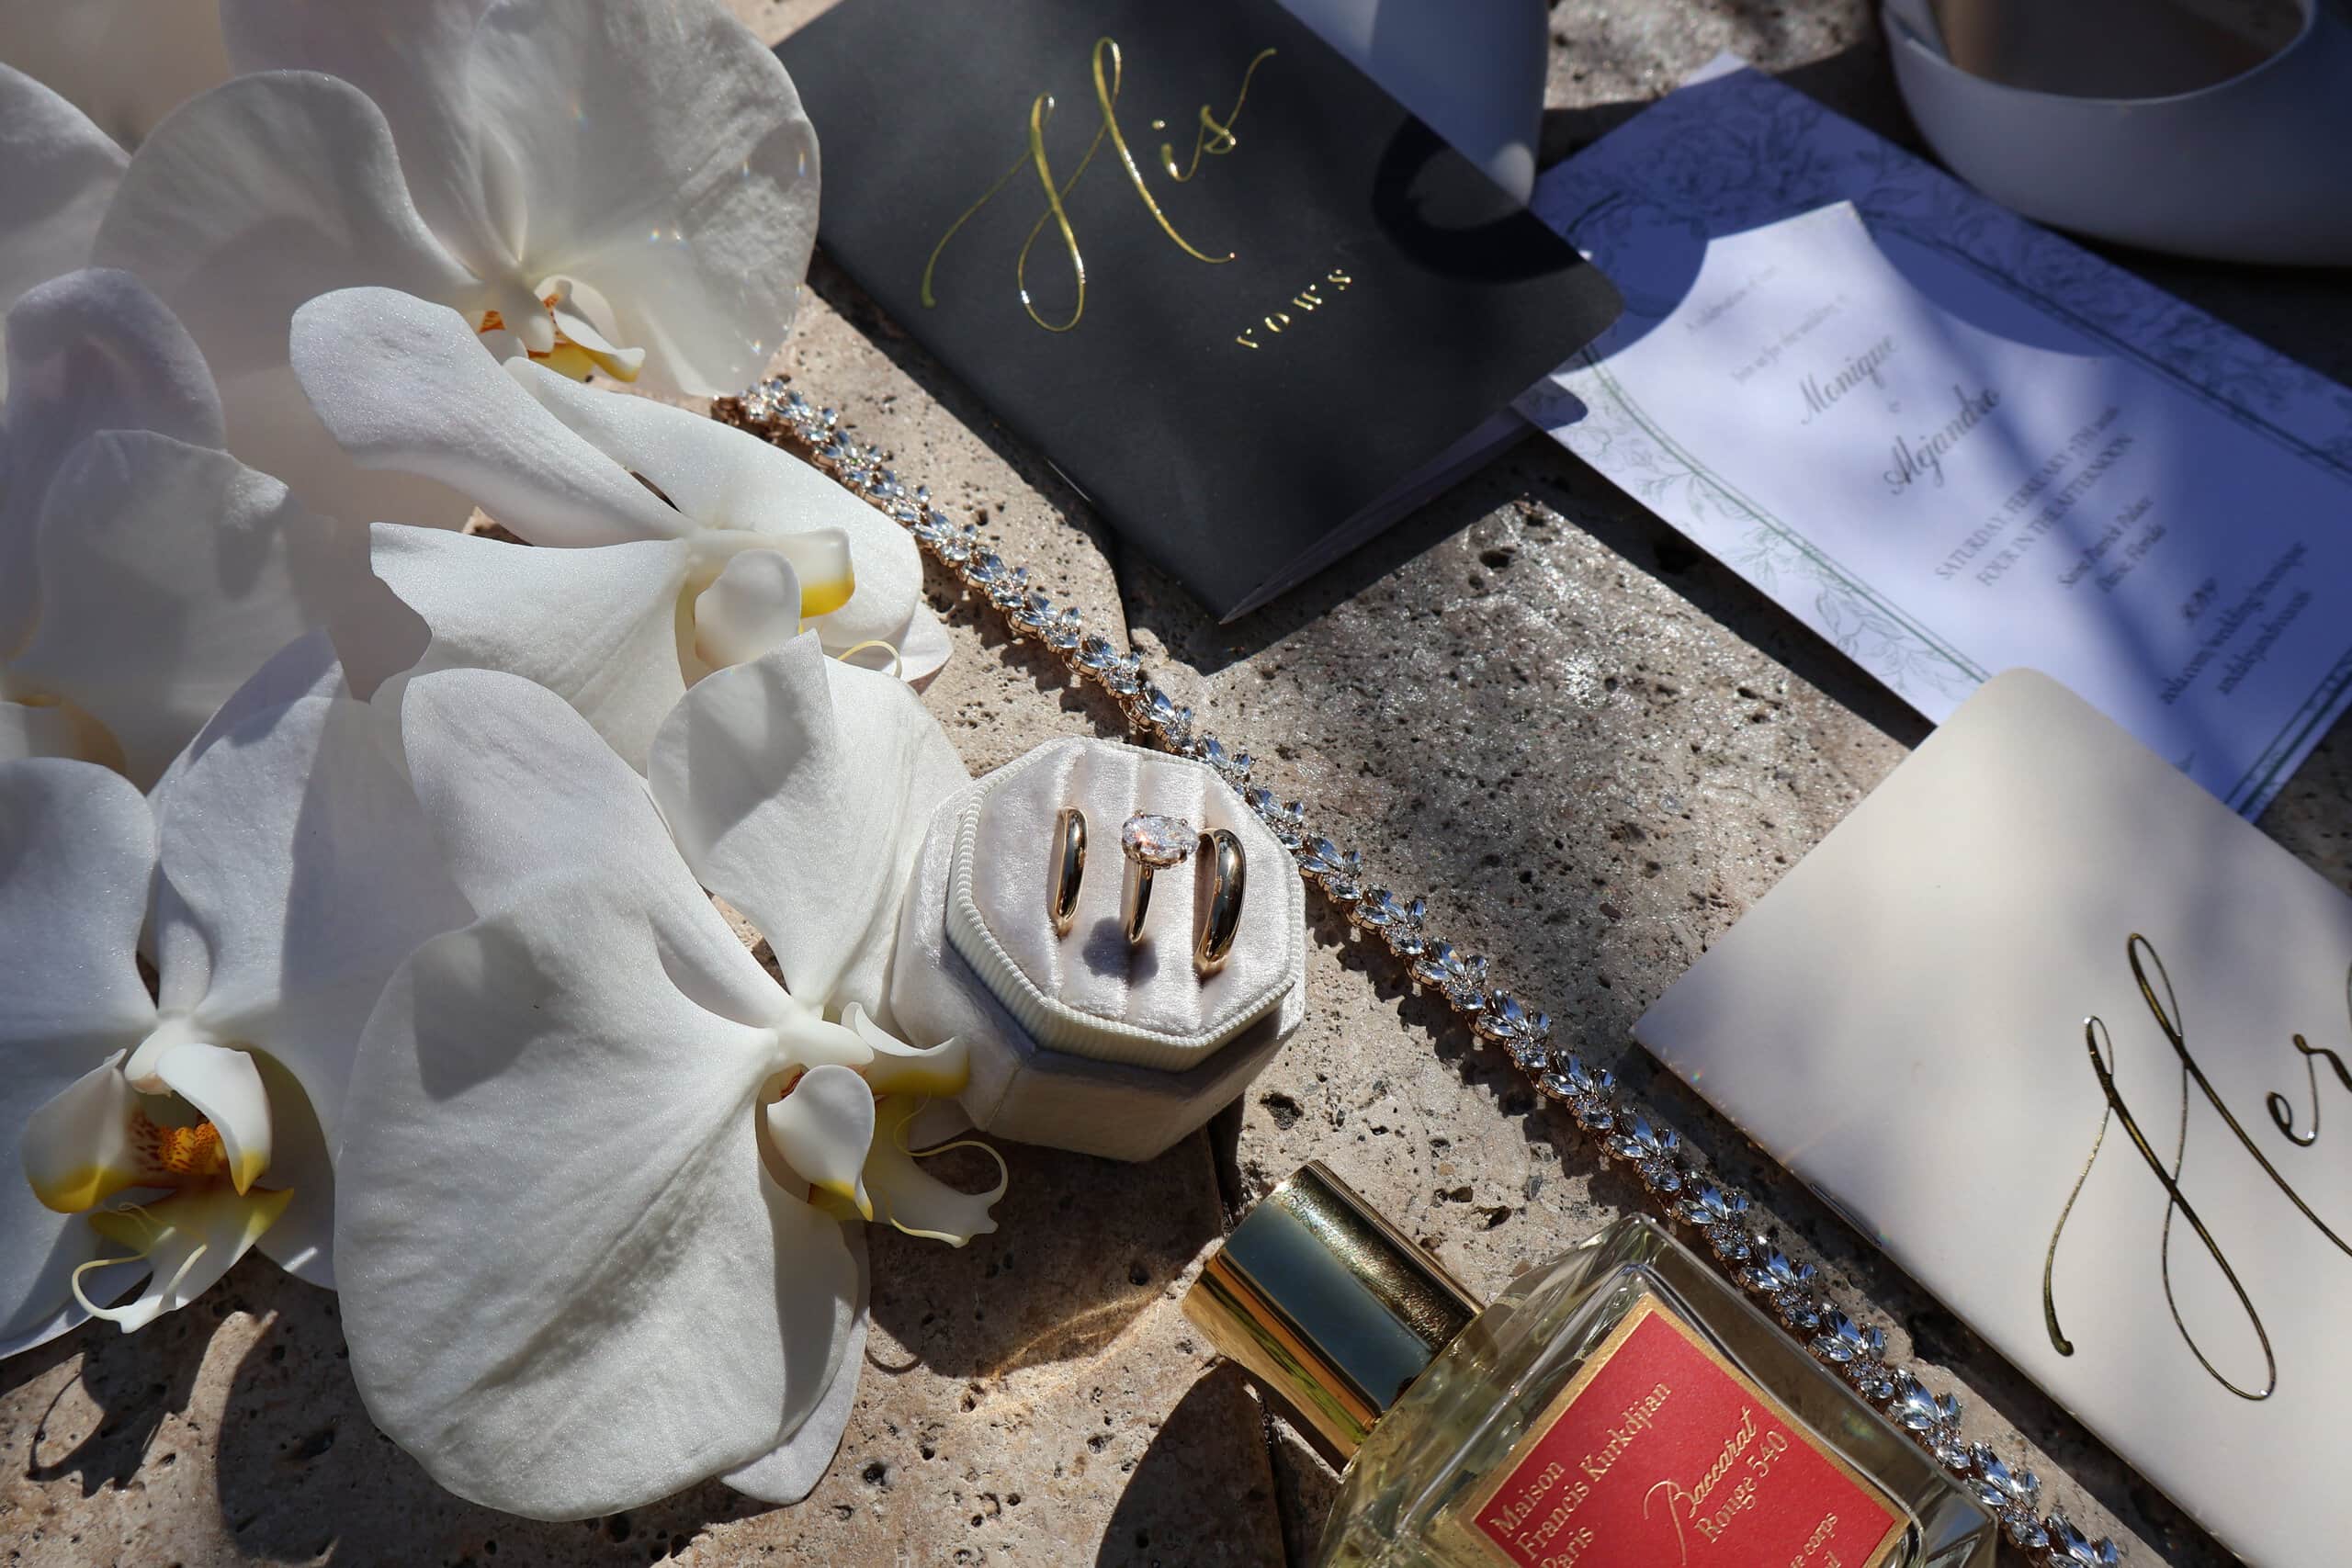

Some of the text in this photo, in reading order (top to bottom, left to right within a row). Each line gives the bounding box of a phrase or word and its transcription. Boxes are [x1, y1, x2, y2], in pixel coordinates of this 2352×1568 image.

[921, 36, 1277, 333] His
[1800, 335, 1898, 426] Monique
[1883, 383, 2000, 496] Alejandro
[1489, 1461, 1566, 1539] Maison
[1514, 1381, 1672, 1561] Francis Kurkdjian
[1643, 1404, 1757, 1566] Baccarat
[1693, 1430, 1788, 1544] Rouge 540
[1804, 1512, 1838, 1555] corps
